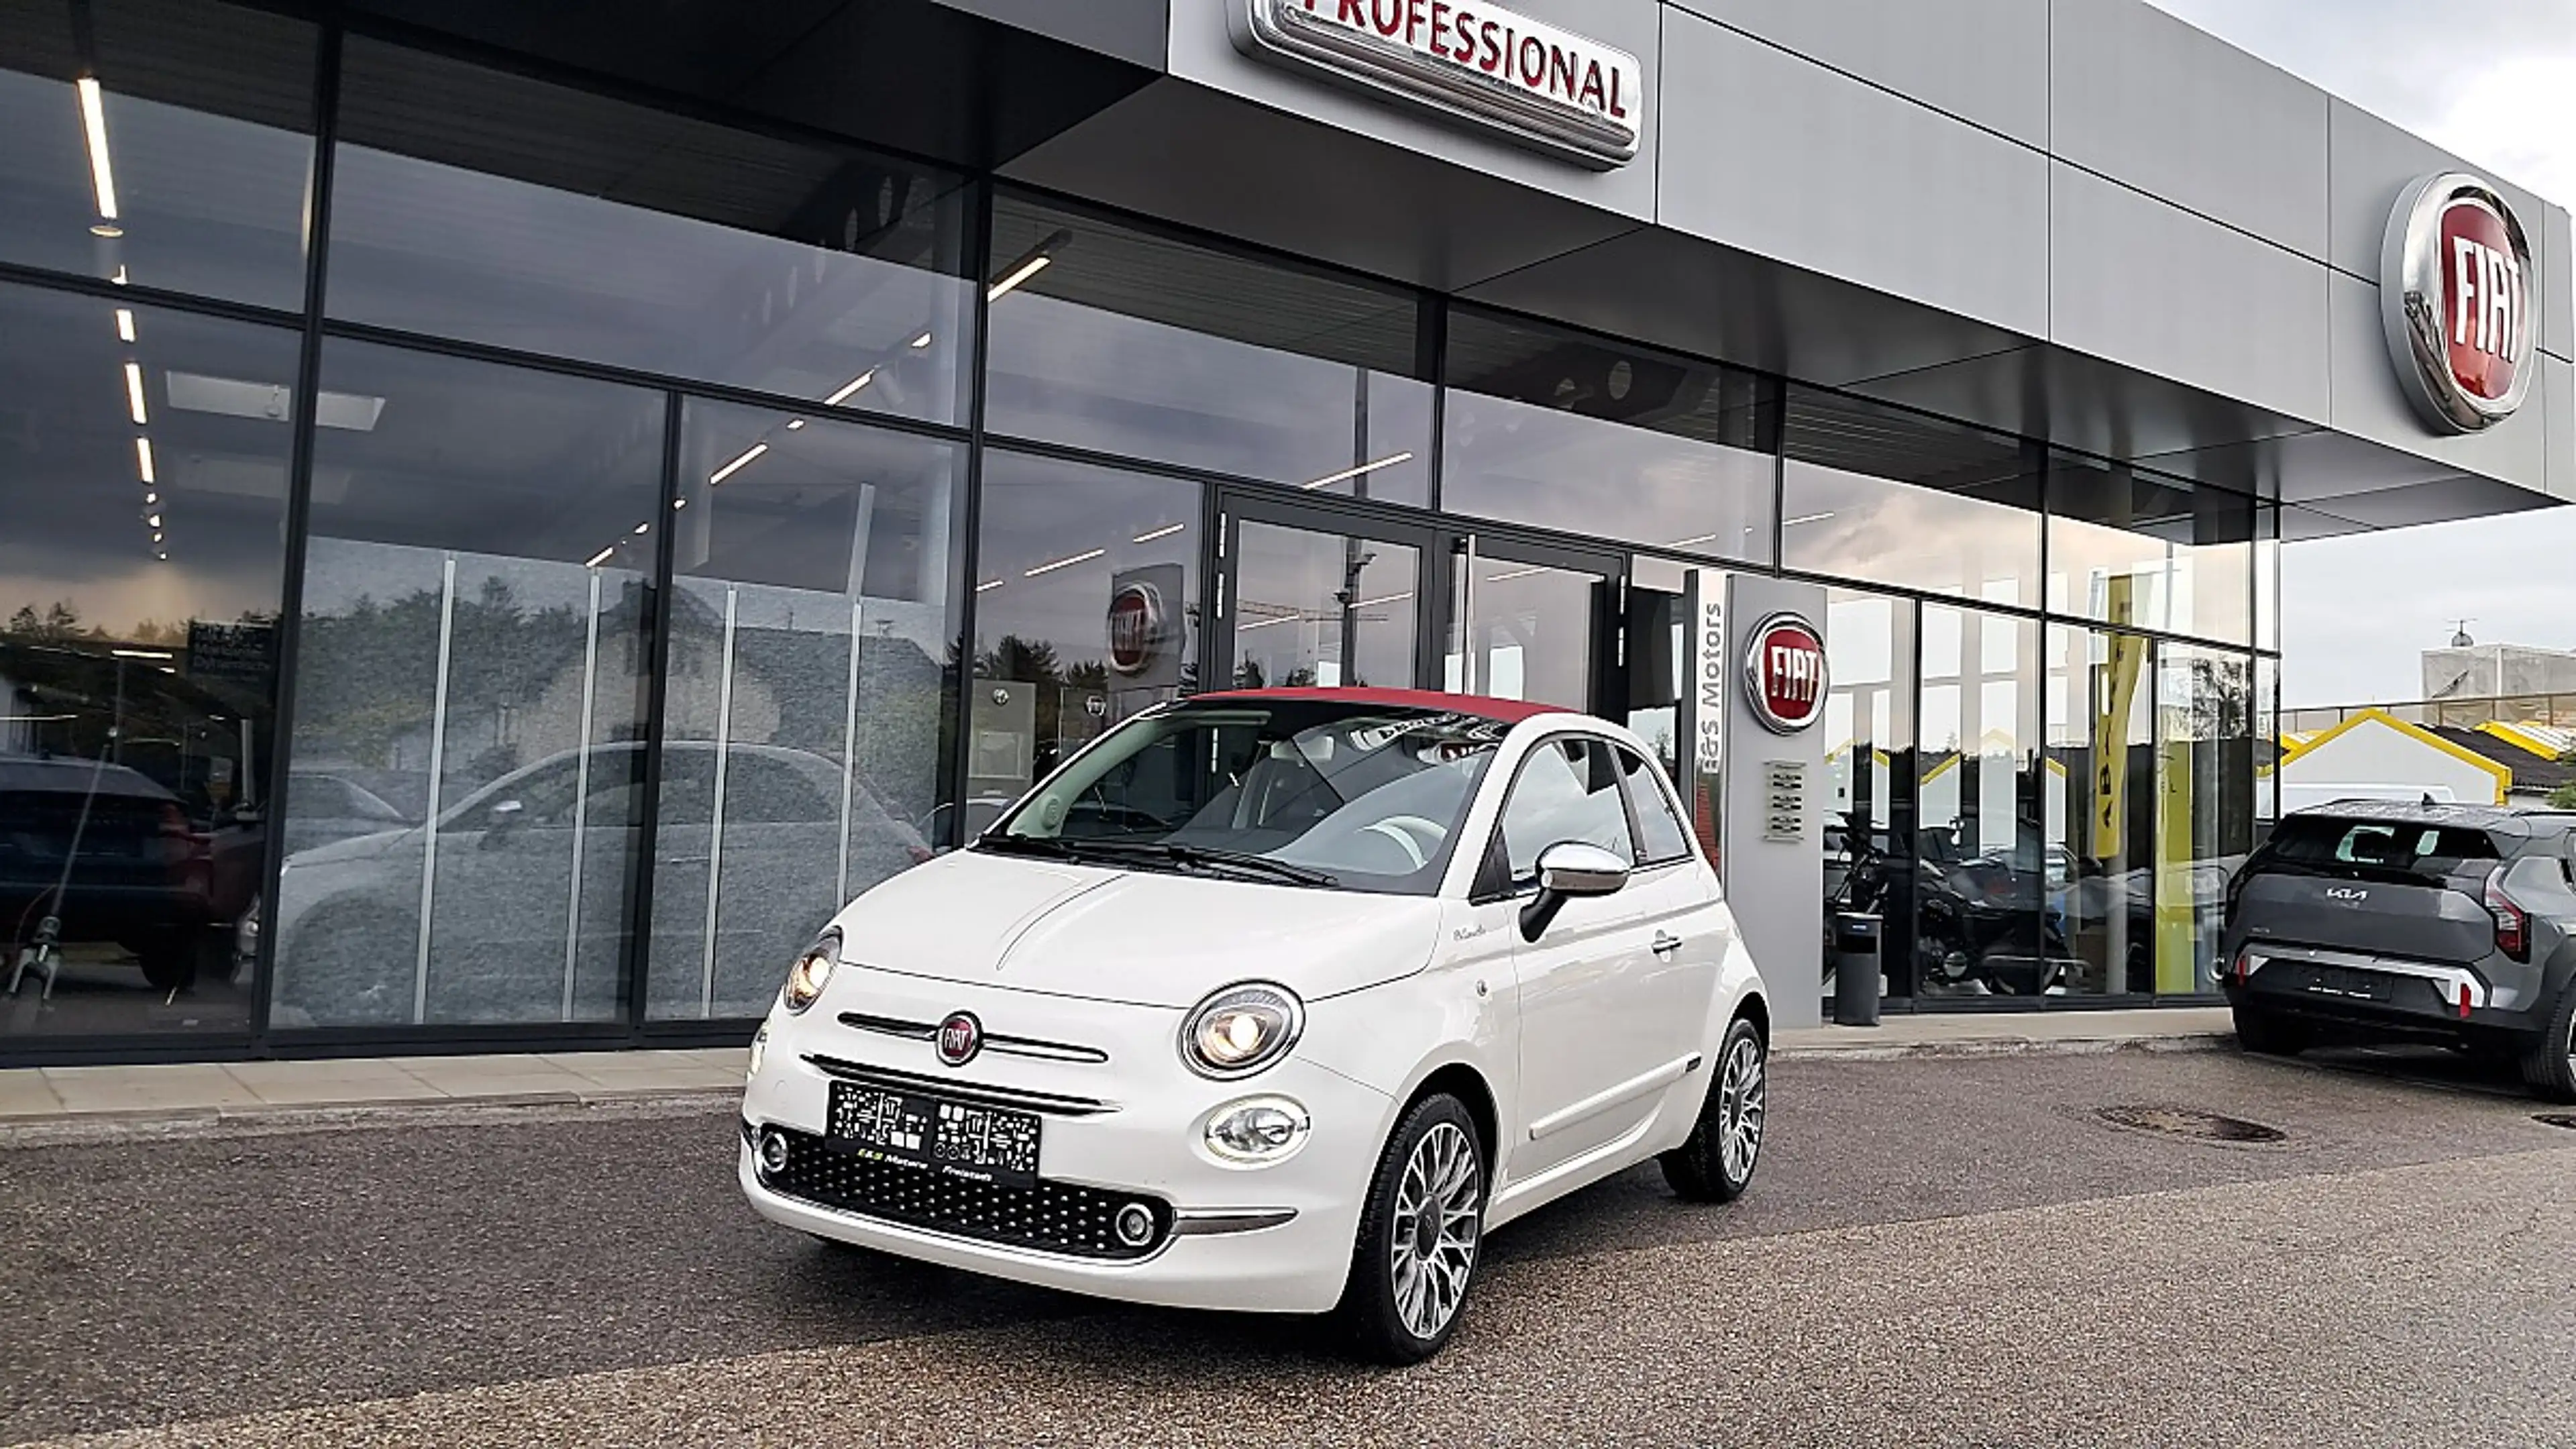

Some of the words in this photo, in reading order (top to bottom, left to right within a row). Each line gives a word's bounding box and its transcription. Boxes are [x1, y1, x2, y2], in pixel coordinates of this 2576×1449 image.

[1303, 0, 1626, 119] ROFESSIONAL
[2453, 235, 2521, 363] FIAT
[1702, 603, 1721, 708] Motors
[1770, 645, 1819, 702] FIAT
[945, 1028, 969, 1051] FIAT
